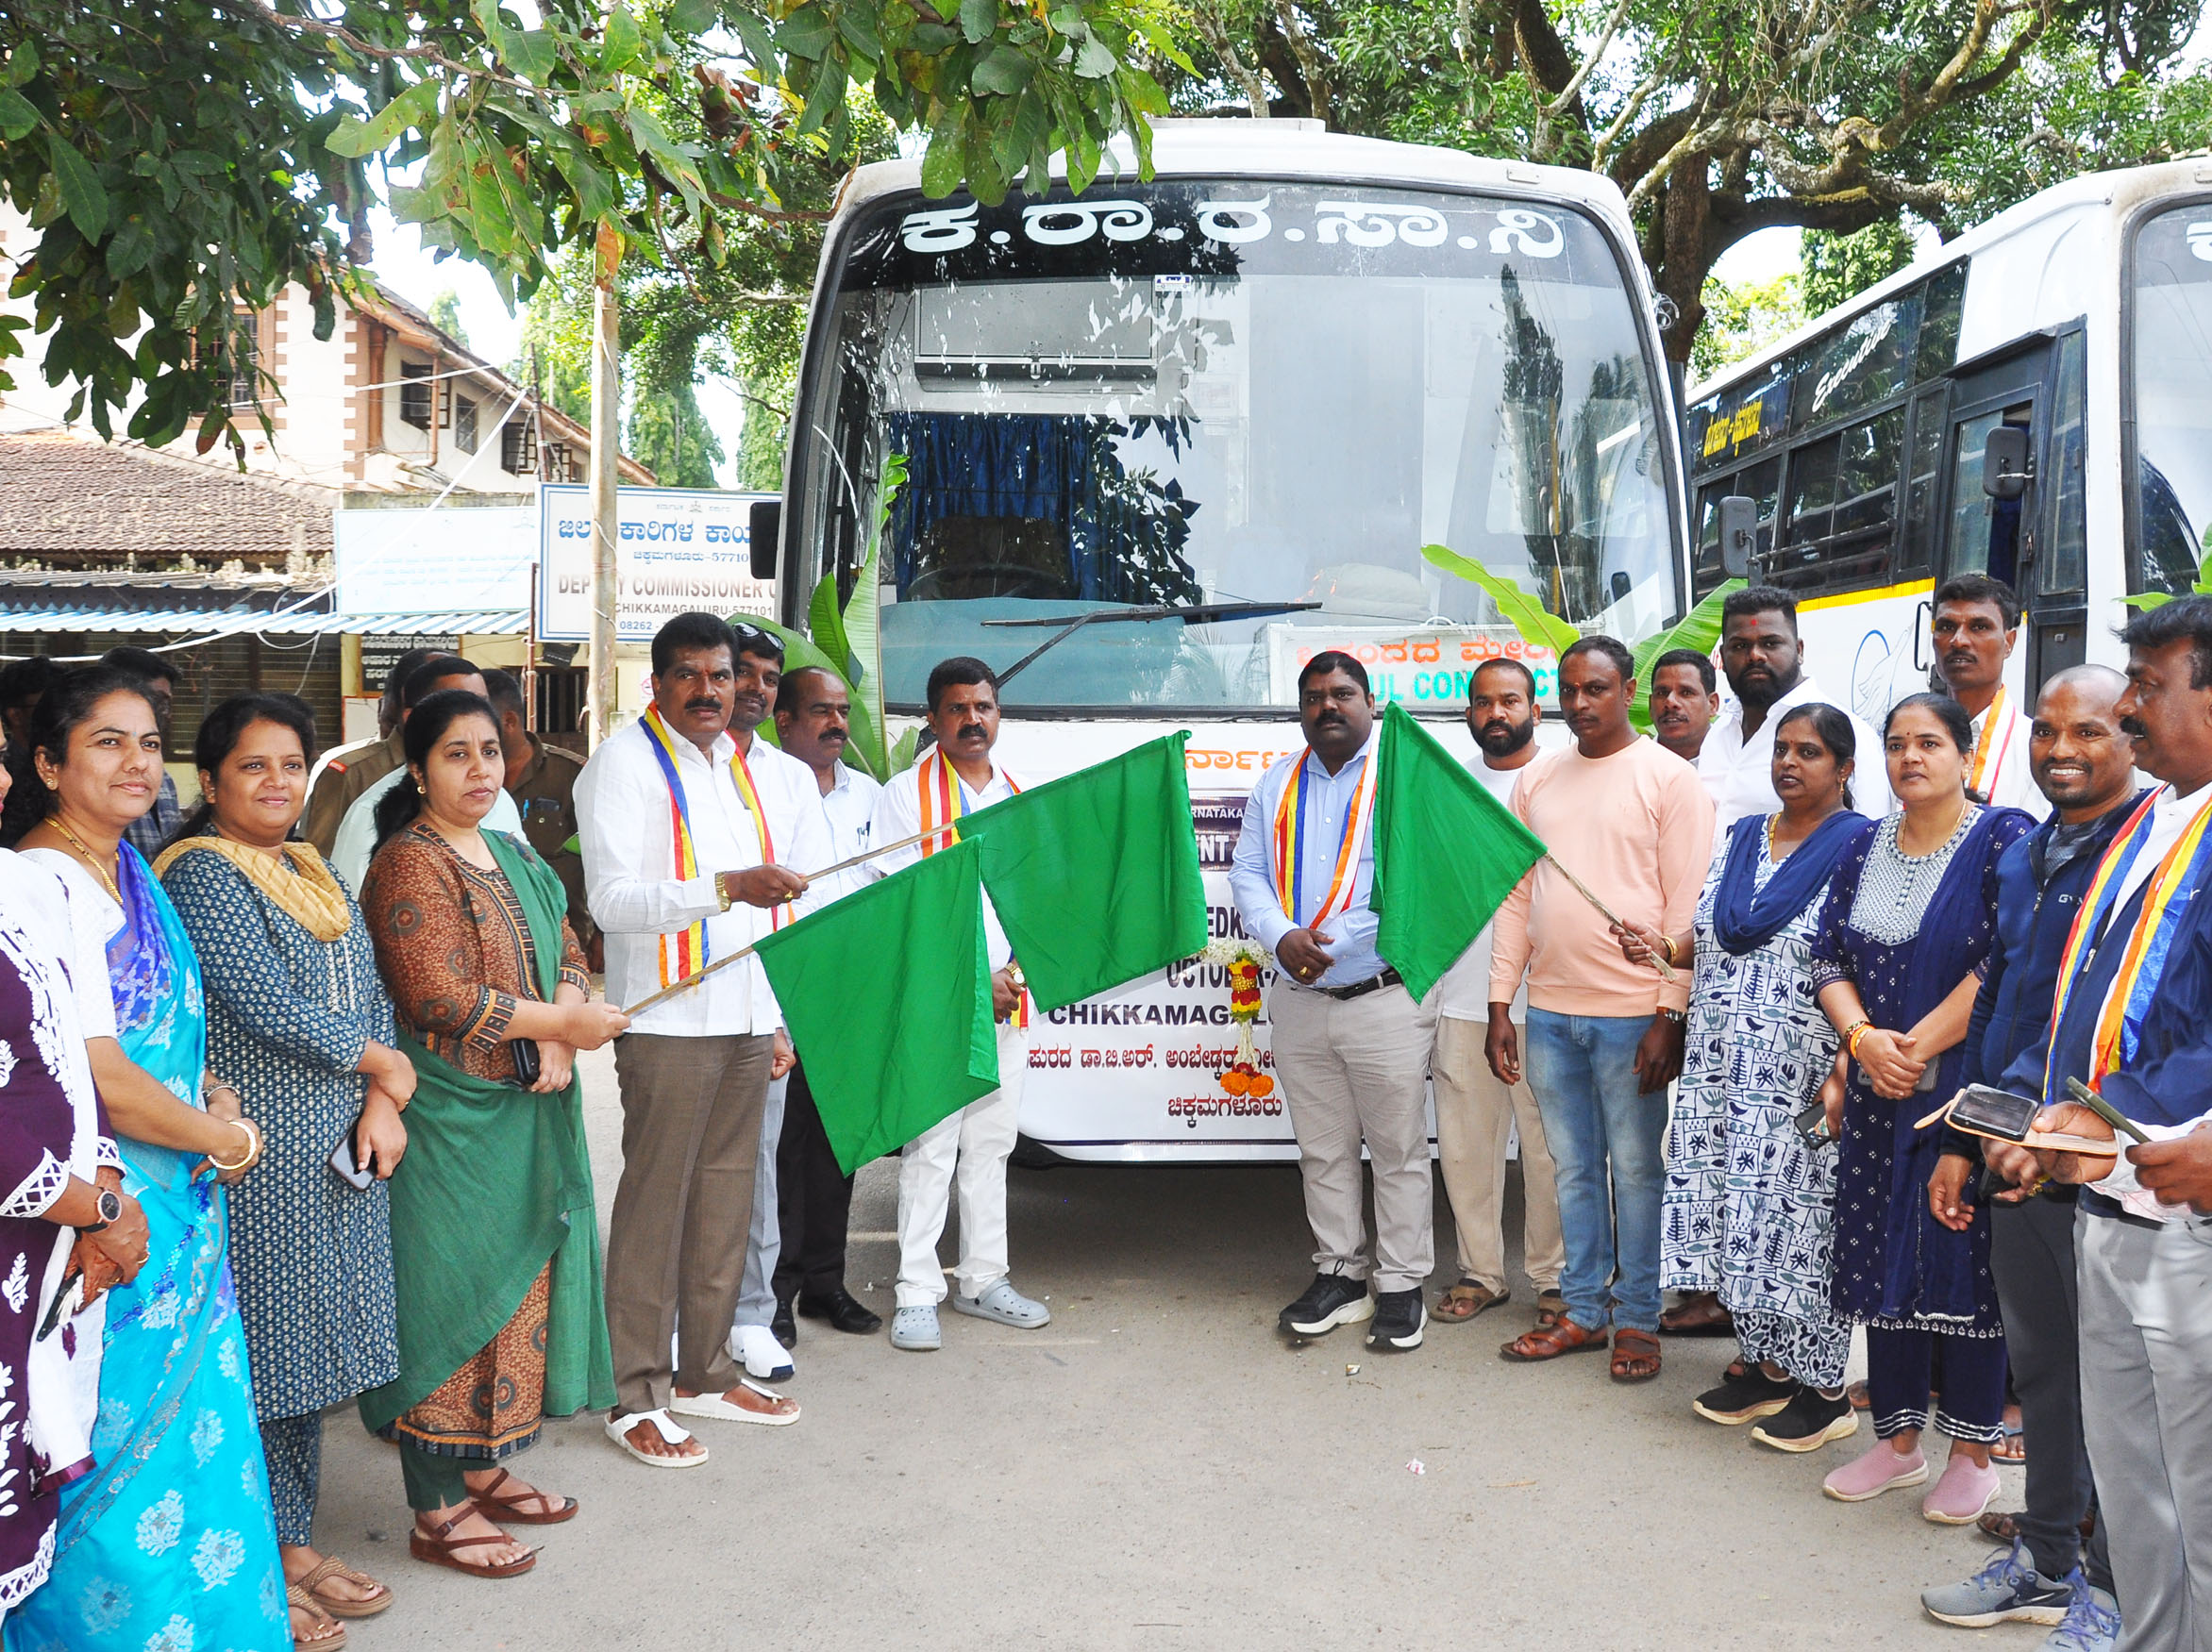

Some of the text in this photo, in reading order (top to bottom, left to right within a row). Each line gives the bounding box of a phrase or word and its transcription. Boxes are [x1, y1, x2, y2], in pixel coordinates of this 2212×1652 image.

[559, 575, 625, 595] DEPY
[633, 577, 763, 598] COMMISSIONER
[619, 620, 652, 630] 08262
[1206, 906, 1257, 940] EDK
[1027, 1043, 1072, 1070] ಪುರದ
[1168, 1092, 1282, 1128] ಚಿಕ್ಕಮಗಳೂರು
